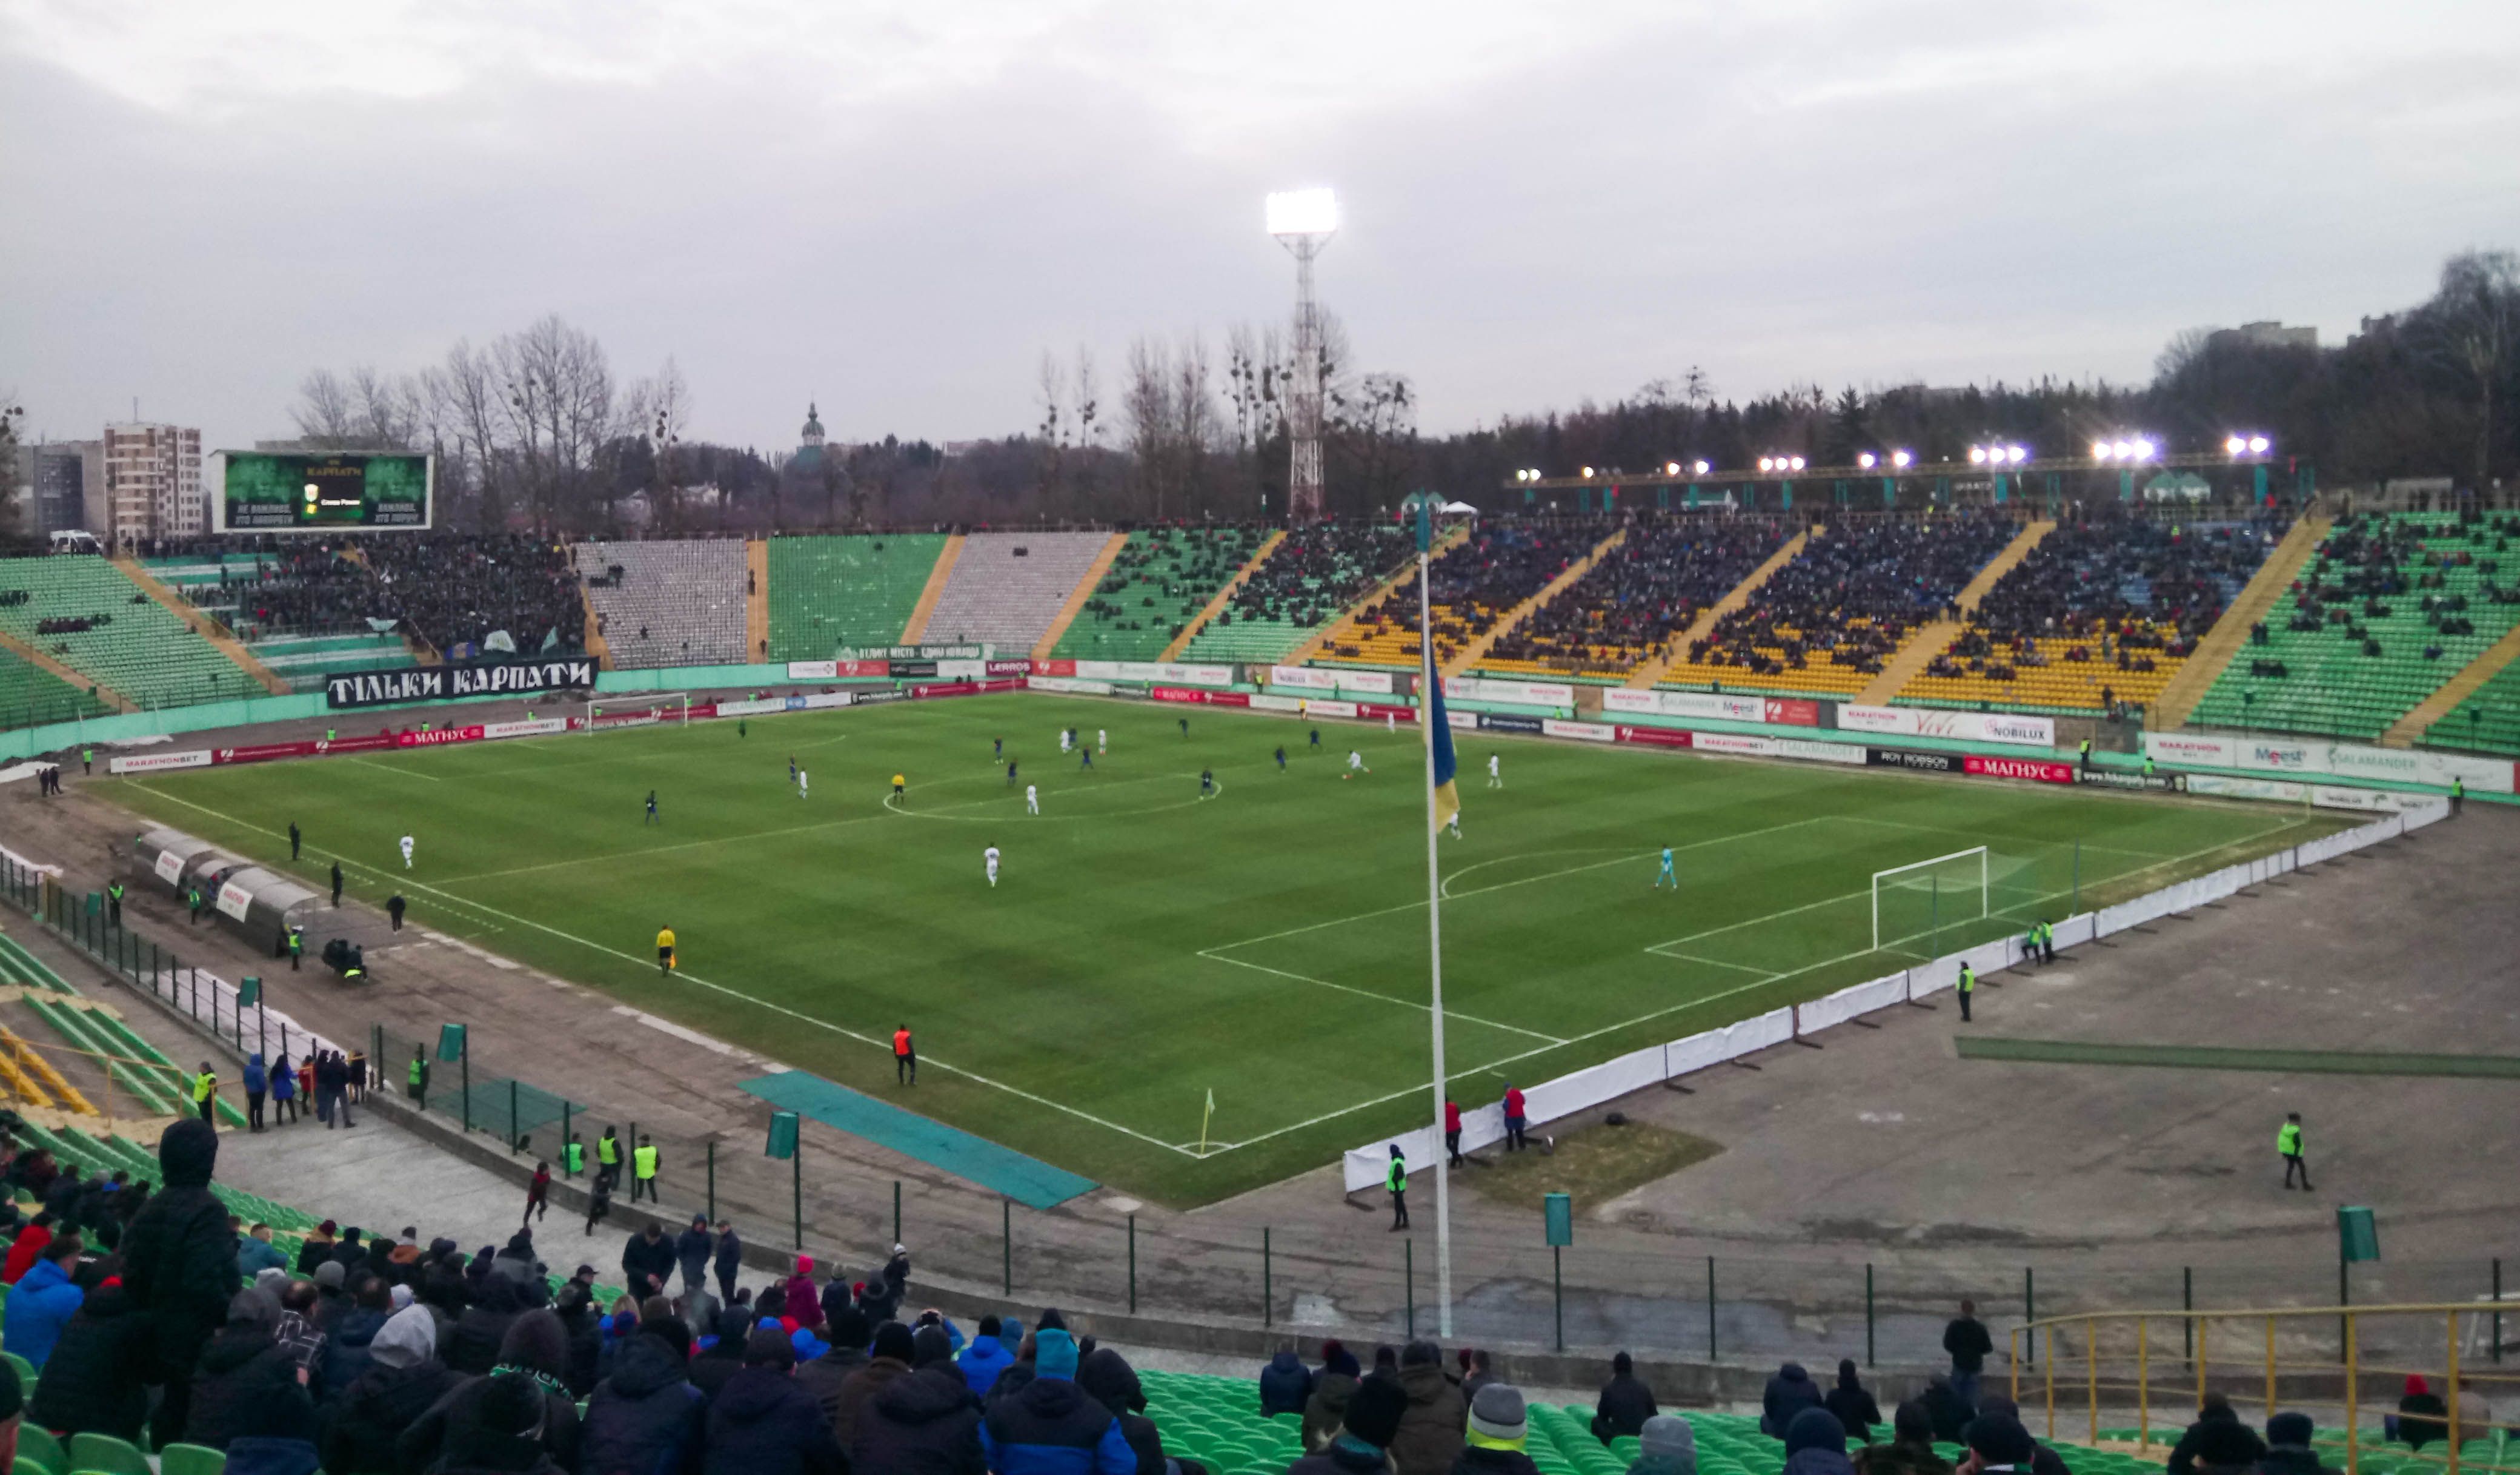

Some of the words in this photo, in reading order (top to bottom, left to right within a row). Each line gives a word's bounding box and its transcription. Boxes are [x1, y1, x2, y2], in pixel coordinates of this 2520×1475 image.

[989, 662, 1030, 672] LERROS
[328, 671, 441, 703] ТІЛЬКИ
[453, 661, 591, 694] КАРПАТИ
[1612, 693, 1651, 703] MARATHON
[1848, 710, 1897, 721] MARATHON
[414, 728, 468, 745] МАГНУС
[1993, 727, 2045, 740] NOBILUX
[1704, 738, 1764, 751] MARATHONBET
[2158, 741, 2221, 752] MARATHON
[125, 755, 199, 768] MARATHONBET
[2336, 751, 2416, 771] SALAMANDER
[1983, 760, 2050, 780] МАГНУС
